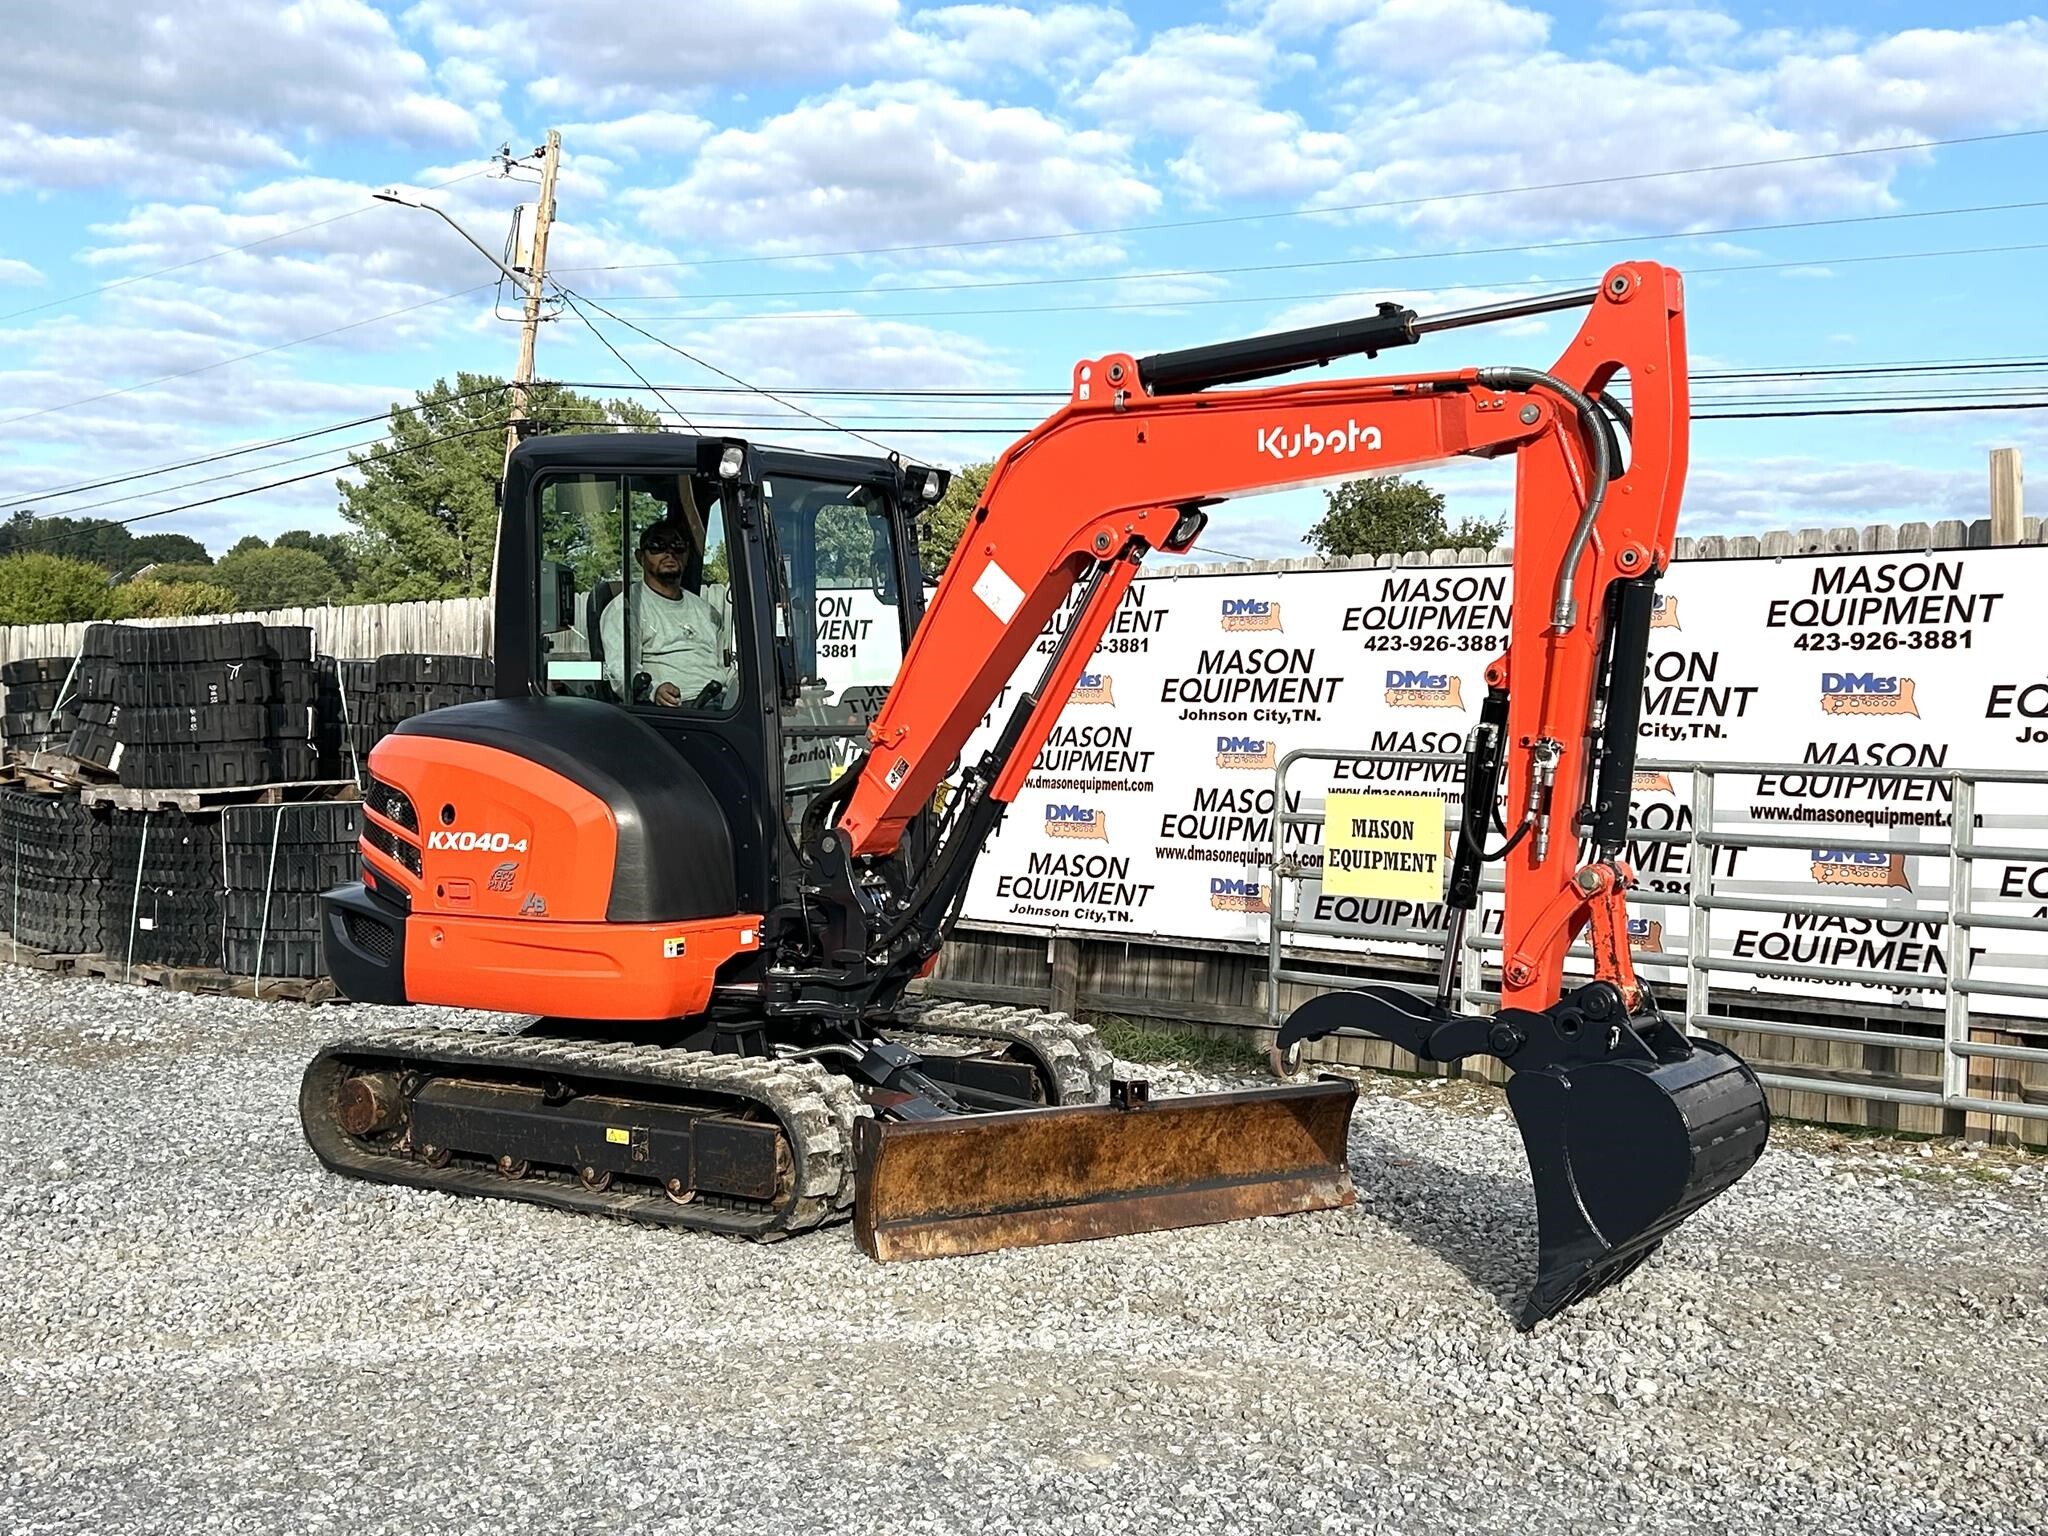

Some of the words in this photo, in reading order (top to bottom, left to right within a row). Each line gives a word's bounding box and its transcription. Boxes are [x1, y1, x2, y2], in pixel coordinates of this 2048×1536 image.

[1257, 418, 1382, 459] Kubota
[1381, 577, 1506, 603] MASON
[1812, 562, 1964, 594] MASON
[1342, 604, 1513, 631] EQUIPMEN
[1766, 593, 2004, 628] EQUIPMENT
[1364, 635, 1510, 652] 423-926-3881
[1793, 630, 1972, 651] 423-926-3881
[1197, 648, 1315, 675] MASON
[1161, 677, 1344, 703] EQUIPMENT
[1178, 709, 1248, 721] Johnson
[1253, 709, 1322, 724] City,TN.
[1046, 726, 1132, 748] MASON
[1371, 731, 1463, 753] MASO
[1638, 722, 1728, 741] City,TN.
[1031, 750, 1155, 773] QUIPMENT
[1803, 742, 1948, 768] MASON
[1021, 776, 1154, 794] w.dmasonequipment.com
[1756, 774, 1953, 802] EQUIPMEN
[1193, 788, 1301, 814] MASON
[427, 831, 528, 853] KX040-4
[1351, 818, 1415, 841] MASON
[1027, 852, 1130, 880] MASON
[1328, 849, 1437, 873] EQUIPMENT
[996, 876, 1155, 907] EQUIPMENT
[1009, 903, 1069, 918] Johnson
[1074, 907, 1135, 923] City,TN.
[1732, 929, 1987, 975] EQUIPMEN
